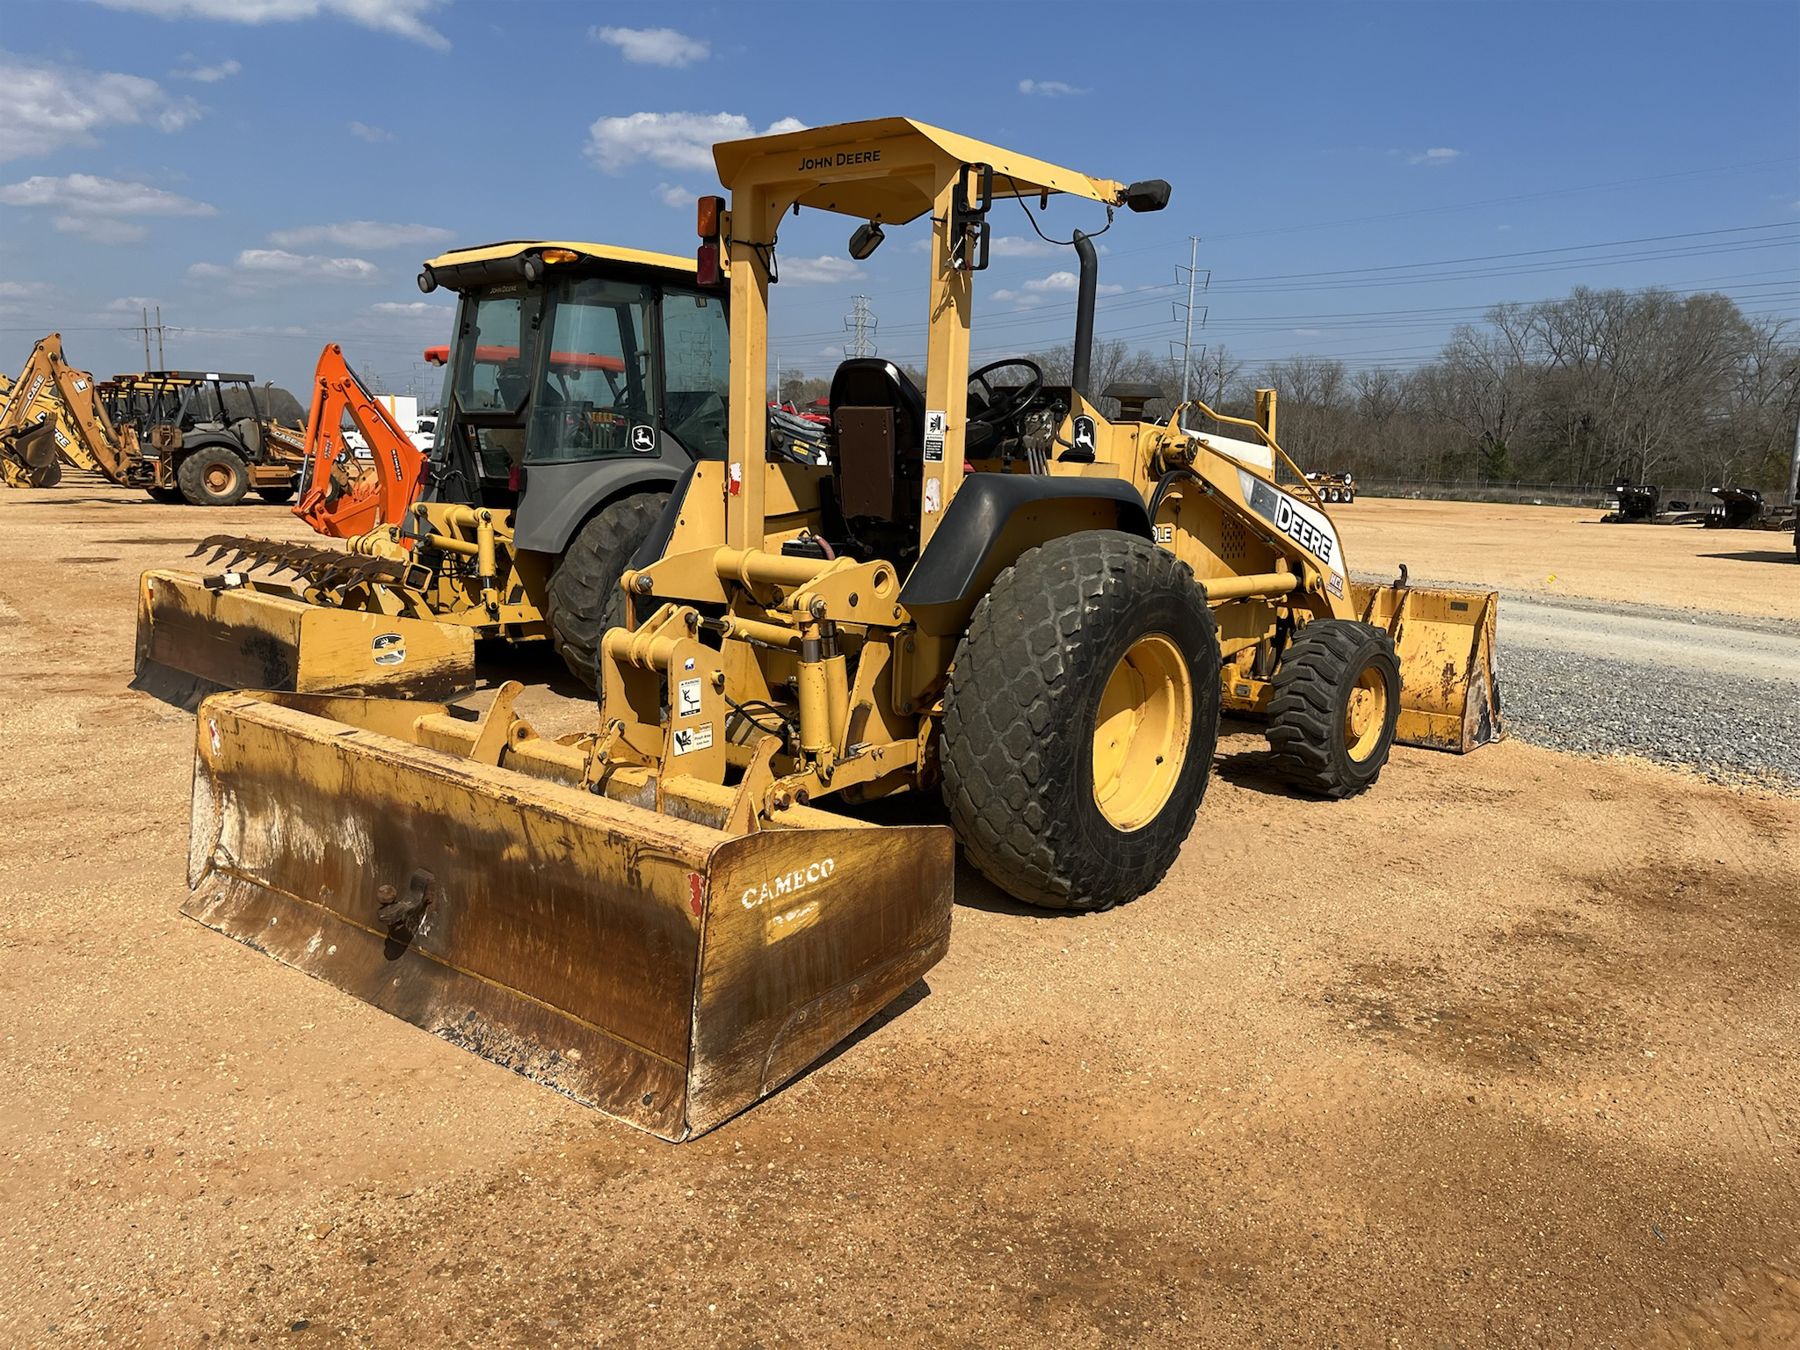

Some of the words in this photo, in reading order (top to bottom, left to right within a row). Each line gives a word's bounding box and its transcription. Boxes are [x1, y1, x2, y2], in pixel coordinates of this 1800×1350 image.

[798, 156, 833, 172] JOHN
[836, 150, 881, 166] DEERE
[27, 374, 45, 400] CASE
[1276, 496, 1333, 565] DEERE
[741, 858, 836, 909] CAMECO
